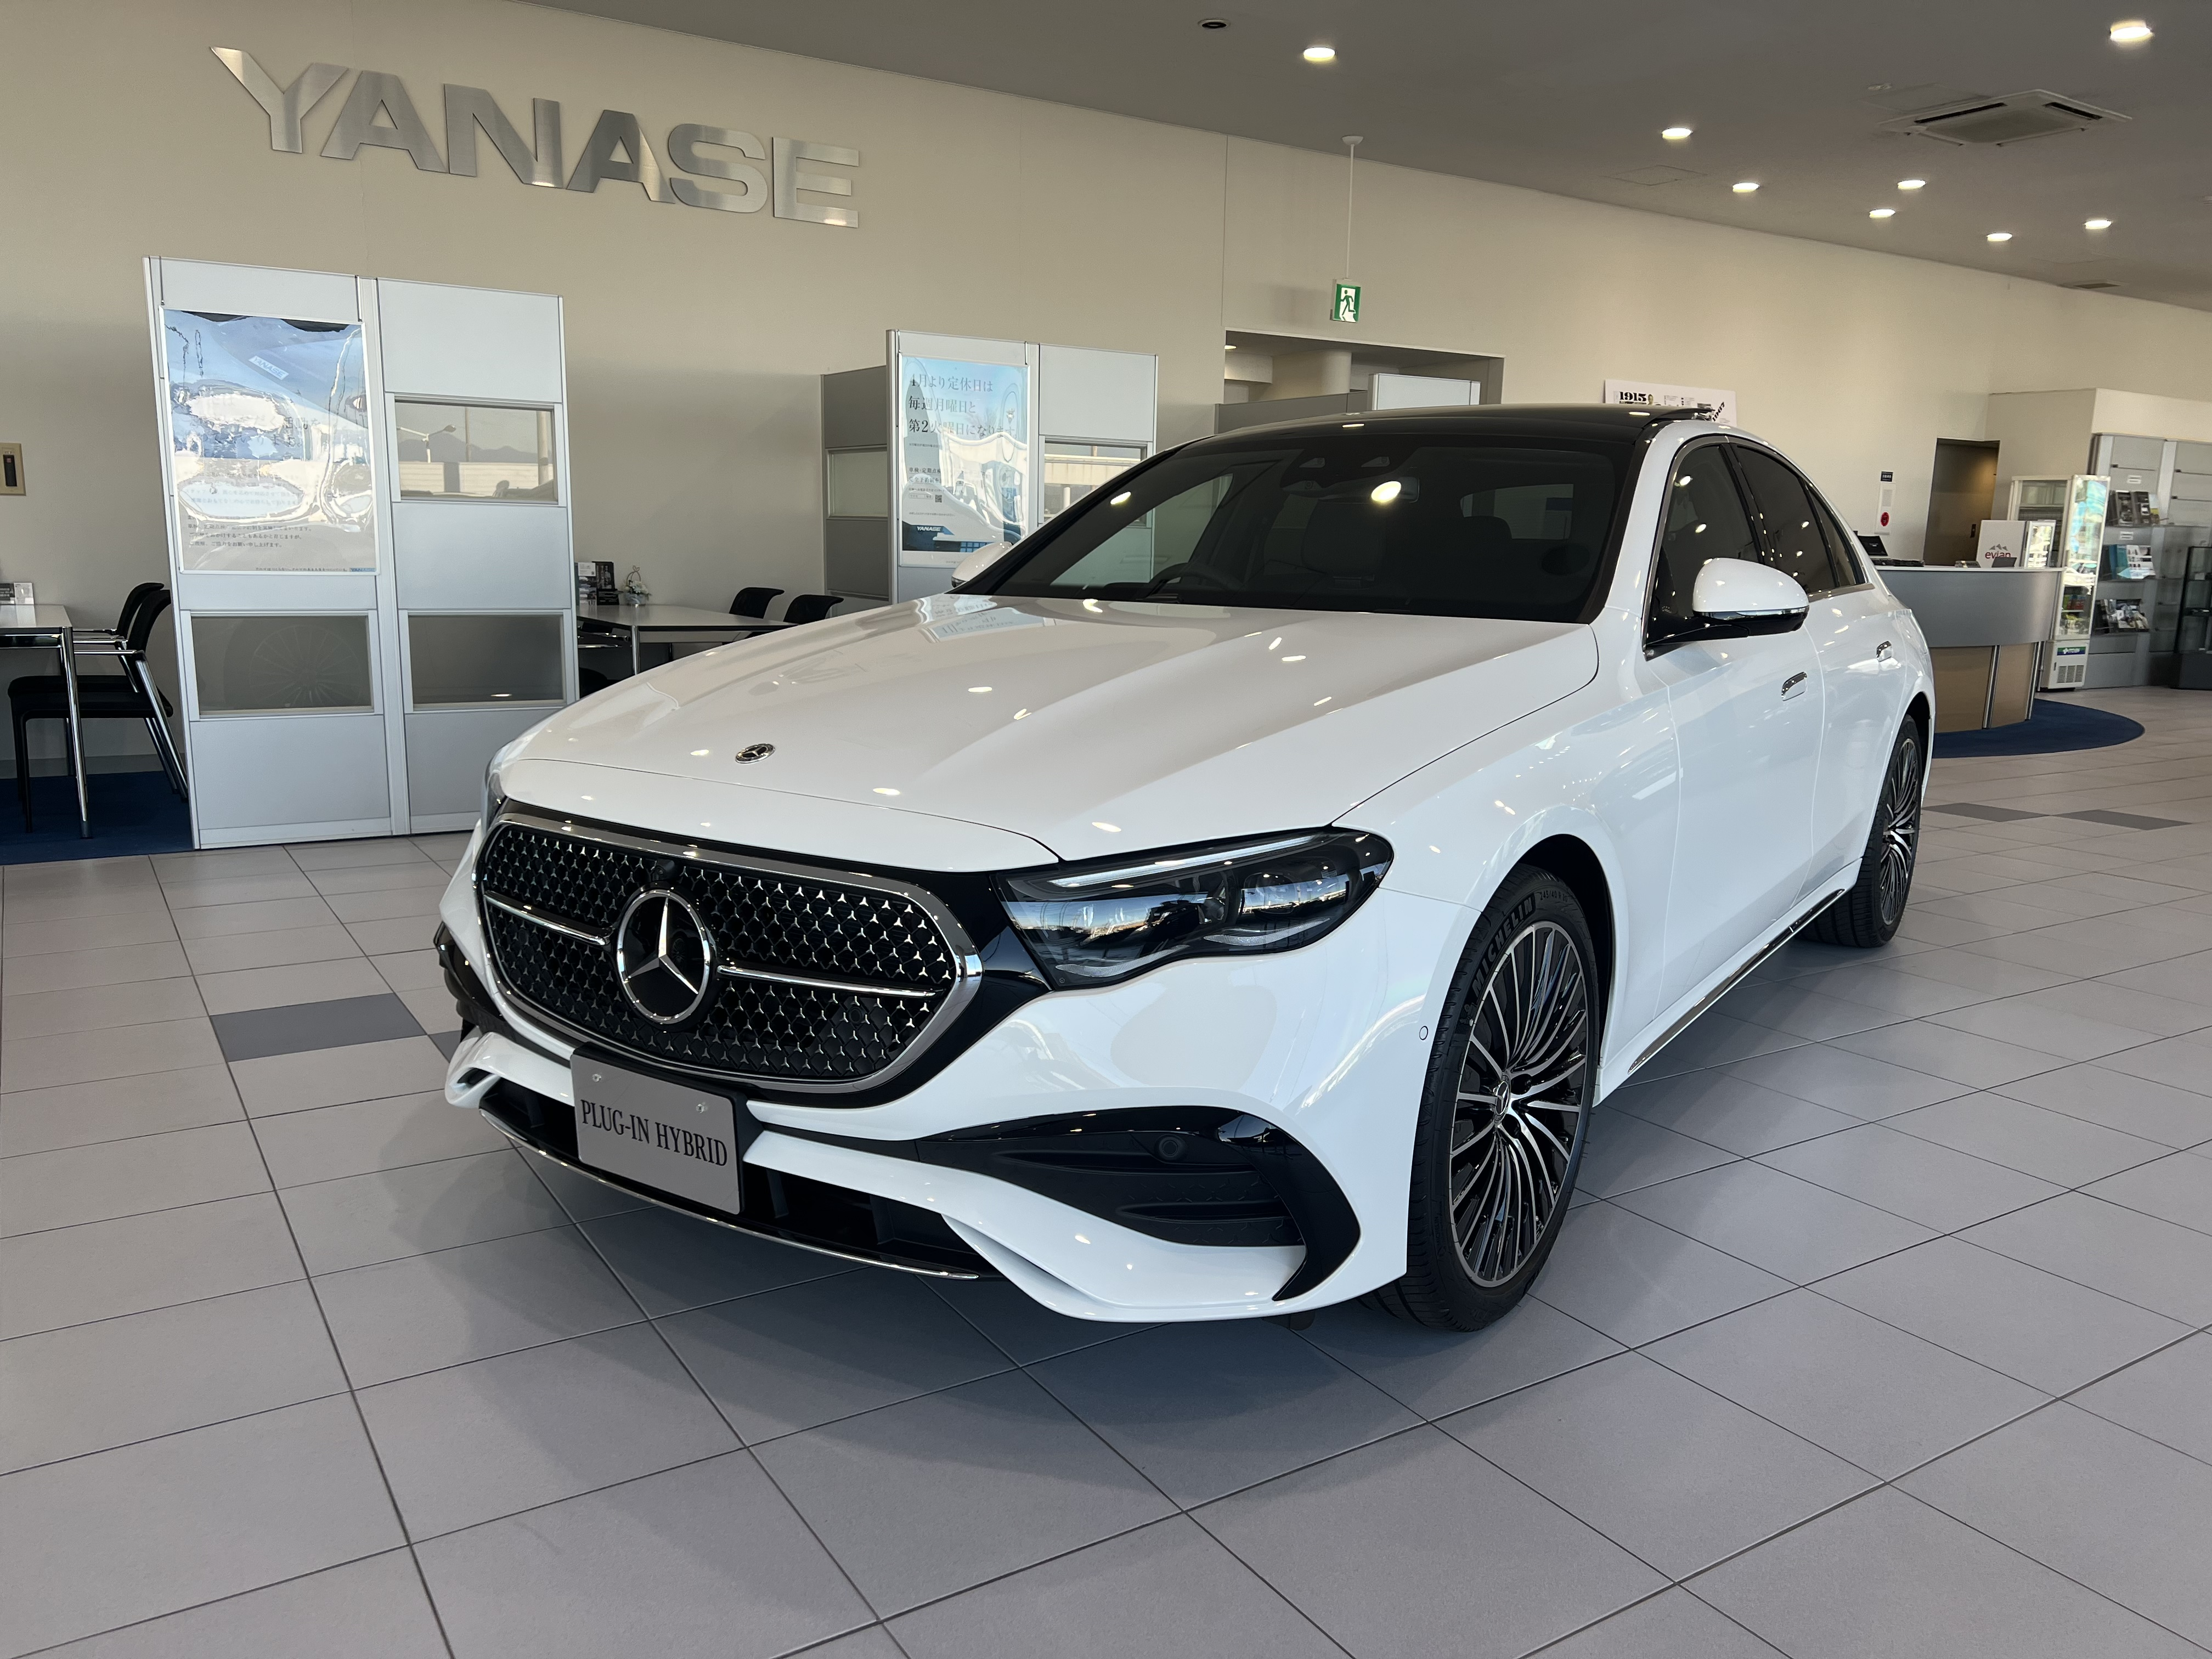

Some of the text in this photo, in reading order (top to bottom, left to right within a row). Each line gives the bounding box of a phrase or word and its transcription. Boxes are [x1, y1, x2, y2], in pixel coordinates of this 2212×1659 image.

[210, 46, 859, 229] YANASE
[253, 357, 286, 378] YANASE
[909, 373, 994, 392] 4月より定休日は
[909, 396, 976, 414] 毎週月曜日と
[1619, 391, 1647, 402] 1915
[1985, 550, 2011, 559] evian
[1472, 896, 1533, 998] MICHELIN
[580, 1099, 727, 1166] PLUG-IN HYBRID
